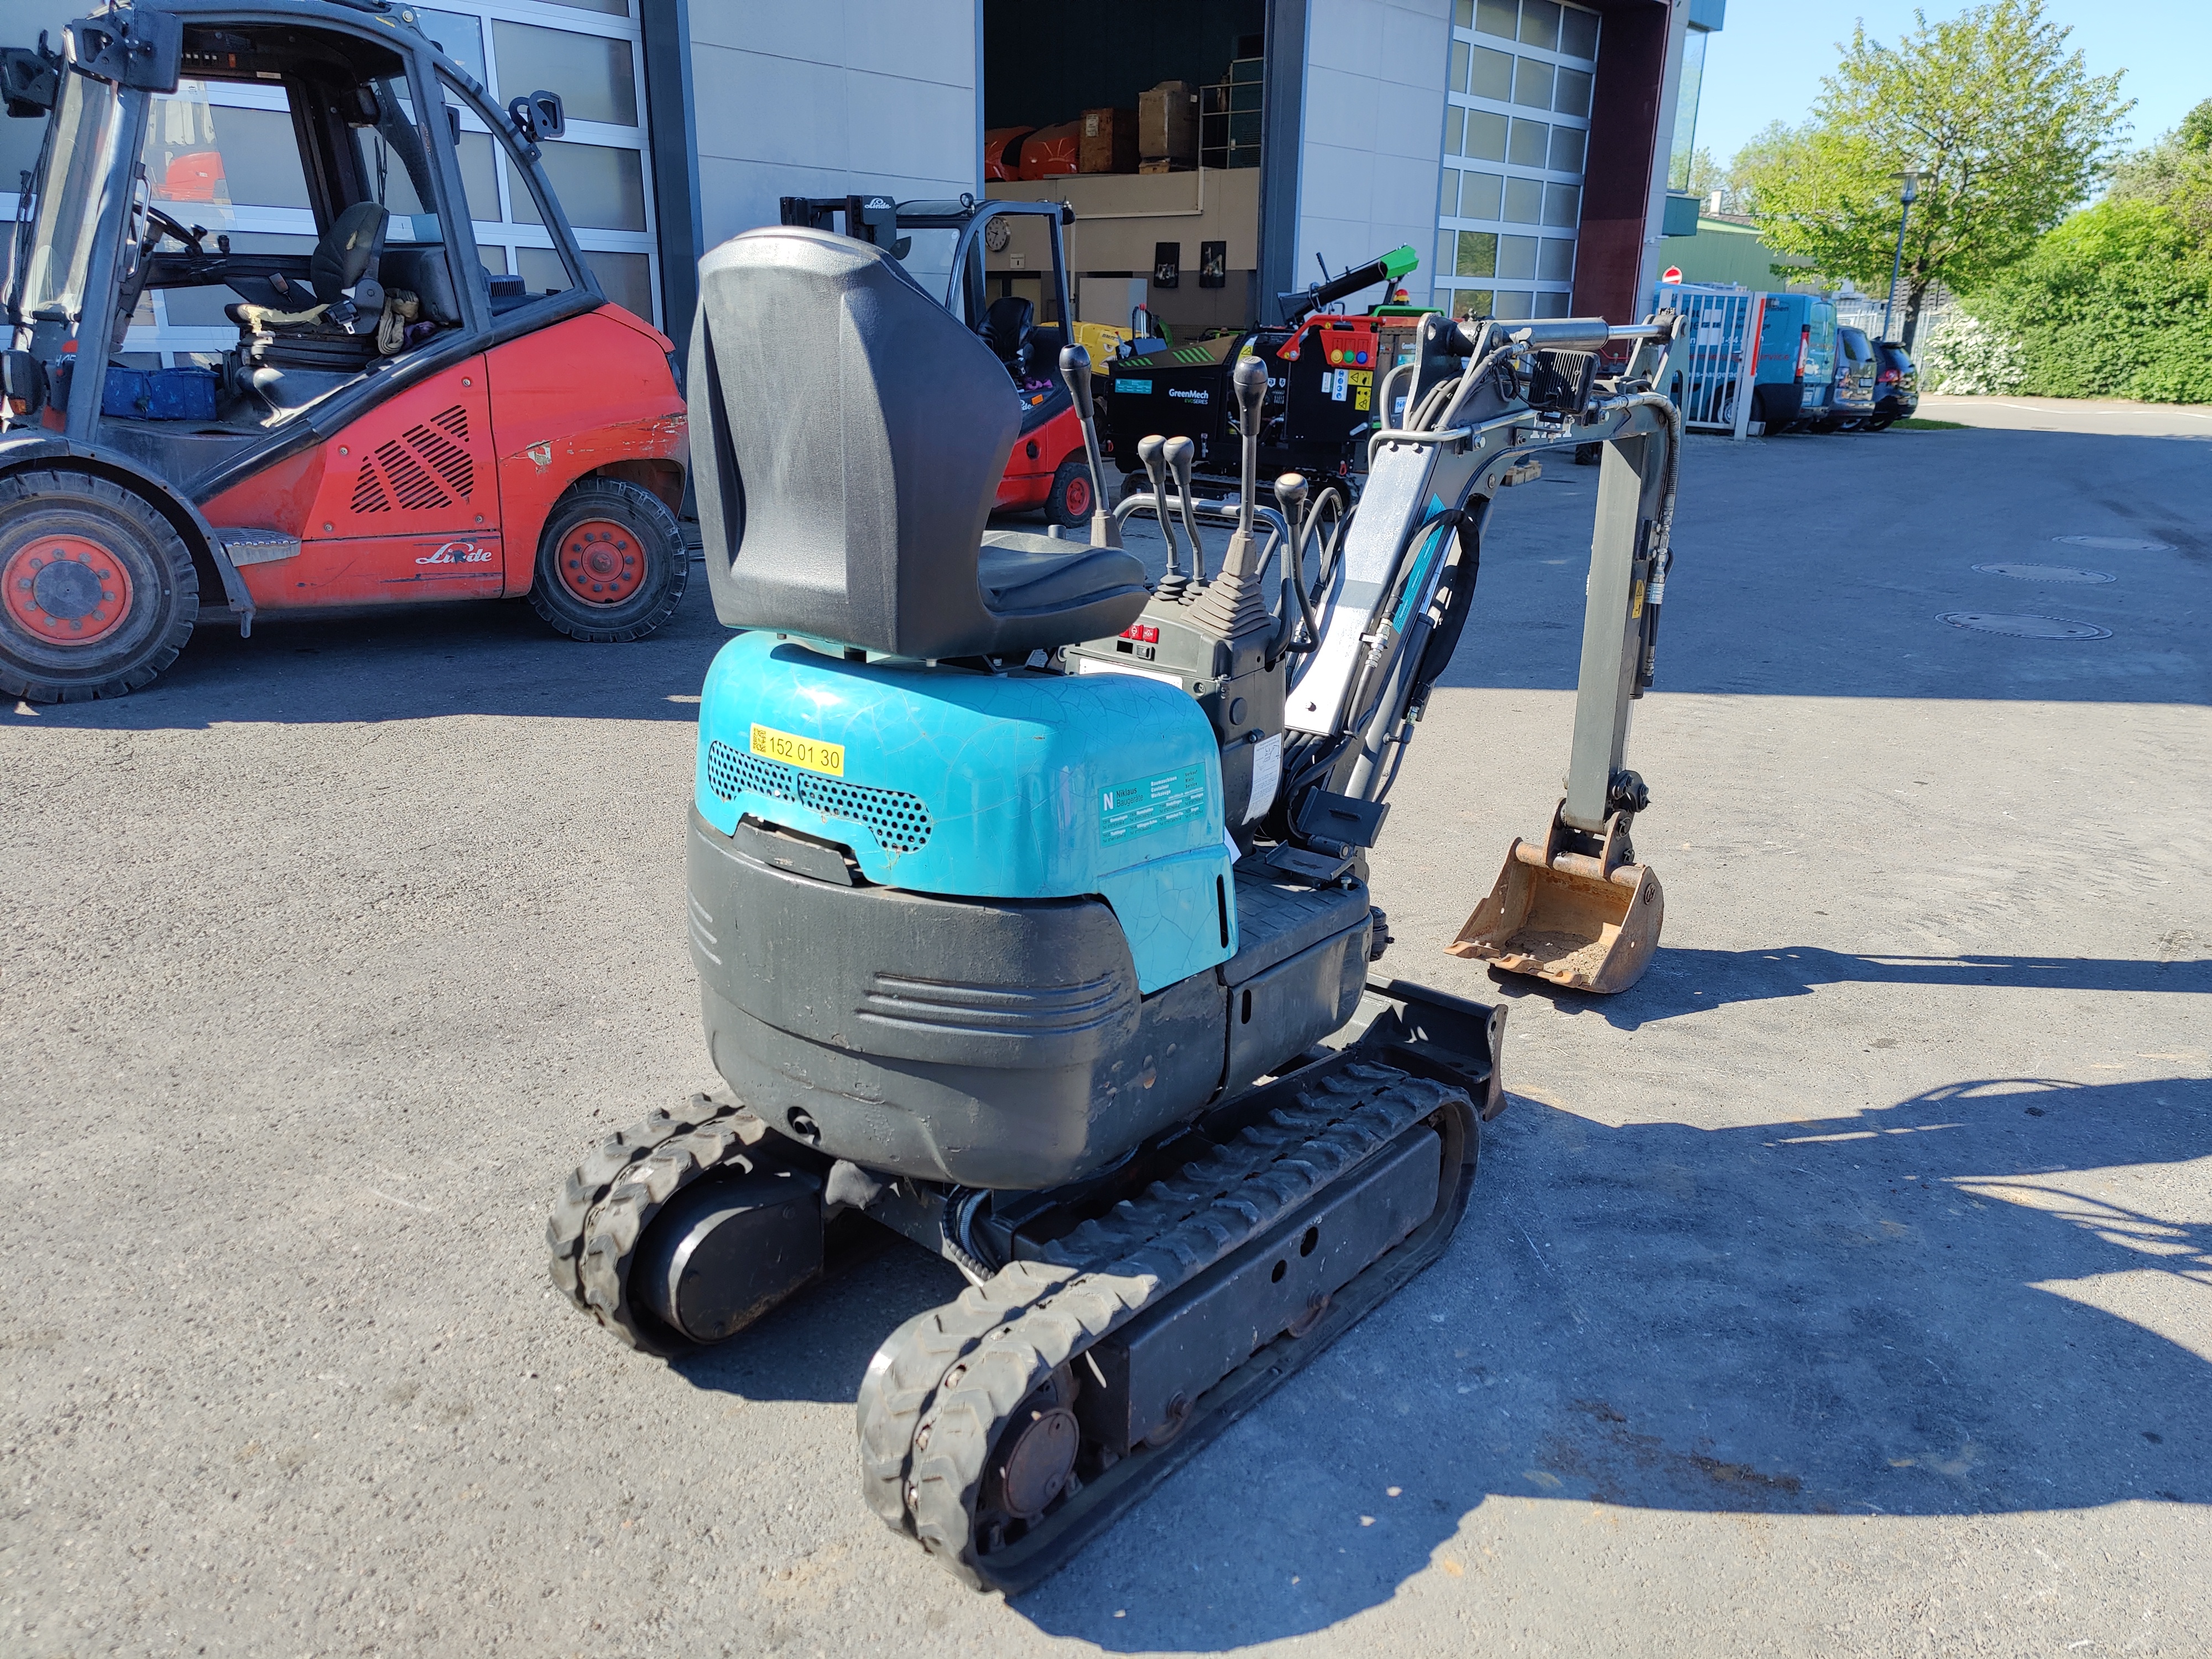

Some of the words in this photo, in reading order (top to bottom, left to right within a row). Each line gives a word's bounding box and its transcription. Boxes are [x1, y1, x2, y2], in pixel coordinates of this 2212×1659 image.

[864, 197, 891, 209] Linde
[1168, 388, 1209, 399] GreenMech
[415, 542, 492, 564] Lide
[770, 737, 792, 758] 152
[798, 744, 813, 763] 01
[821, 749, 839, 769] 30
[1116, 787, 1138, 799] Niklaus
[1103, 791, 1114, 811] N
[1117, 794, 1144, 808] Baugeräte
